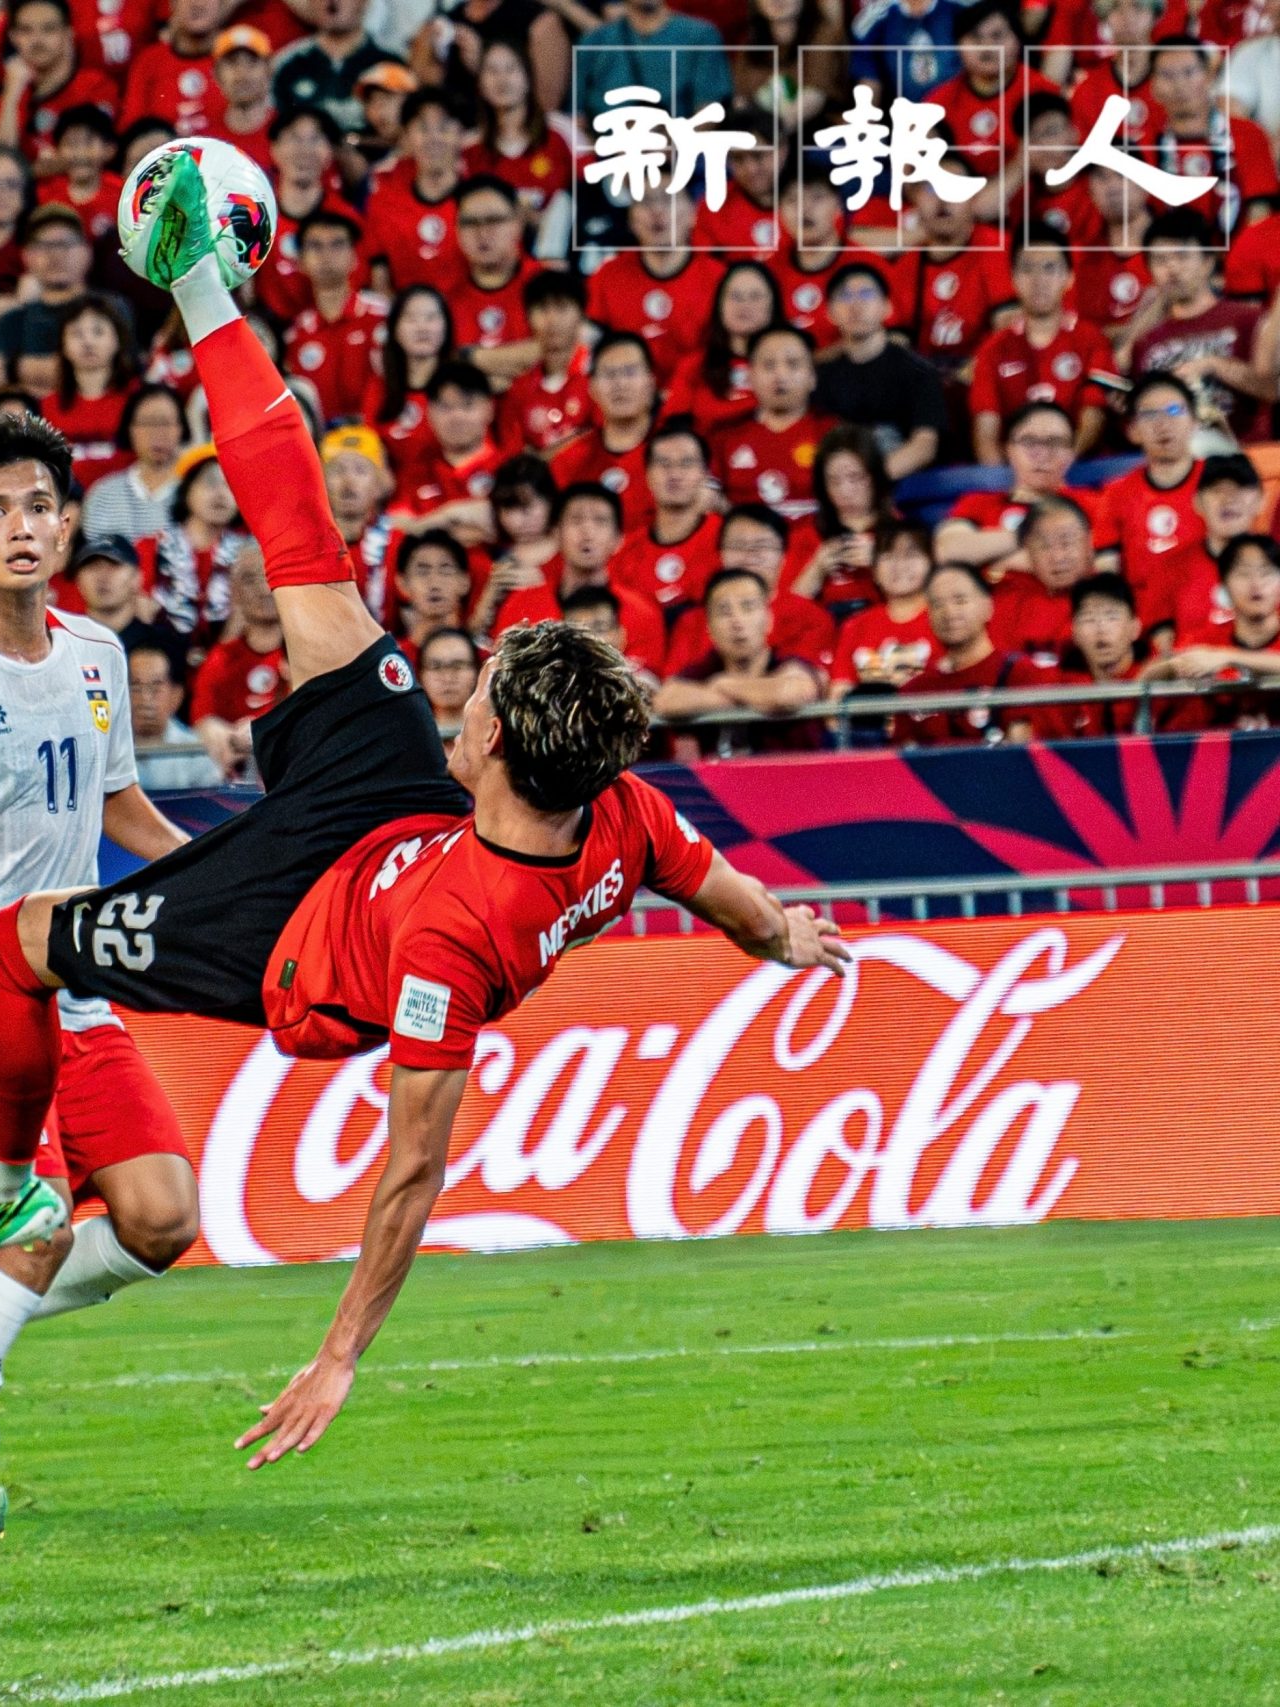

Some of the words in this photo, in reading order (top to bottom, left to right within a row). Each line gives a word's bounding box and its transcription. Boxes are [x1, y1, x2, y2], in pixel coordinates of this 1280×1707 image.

[38, 736, 78, 814] 11
[92, 892, 165, 971] 22
[407, 997, 436, 1013] UNITES
